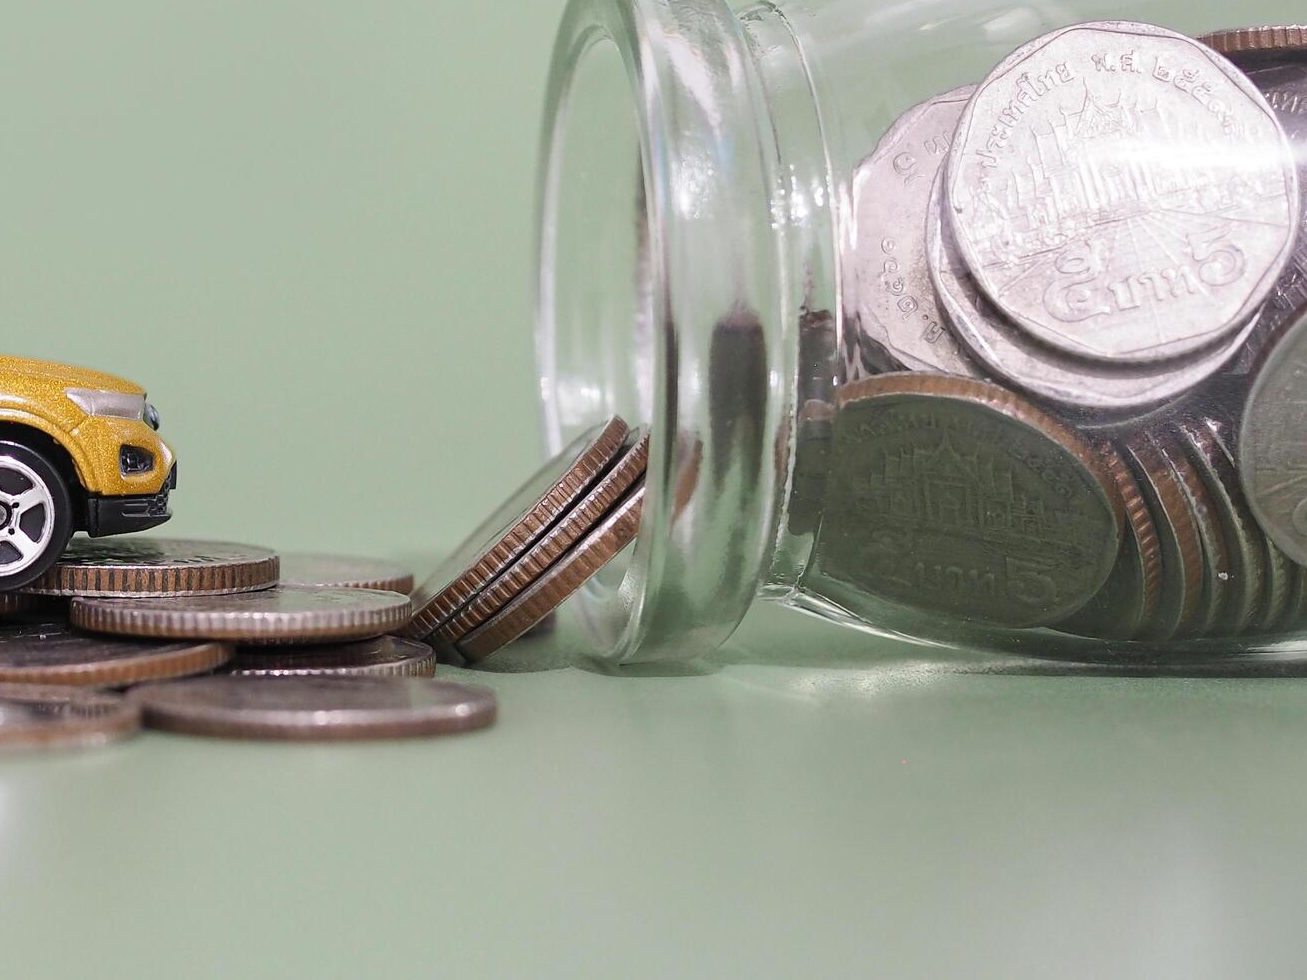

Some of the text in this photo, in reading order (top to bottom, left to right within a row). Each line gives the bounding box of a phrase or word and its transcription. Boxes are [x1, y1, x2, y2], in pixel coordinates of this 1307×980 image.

[975, 61, 1076, 169] ประเทศไทย
[1090, 49, 1142, 74] พ.ศ.
[1042, 221, 1247, 323] ๕ บาท 5
[1005, 556, 1059, 606] 5
